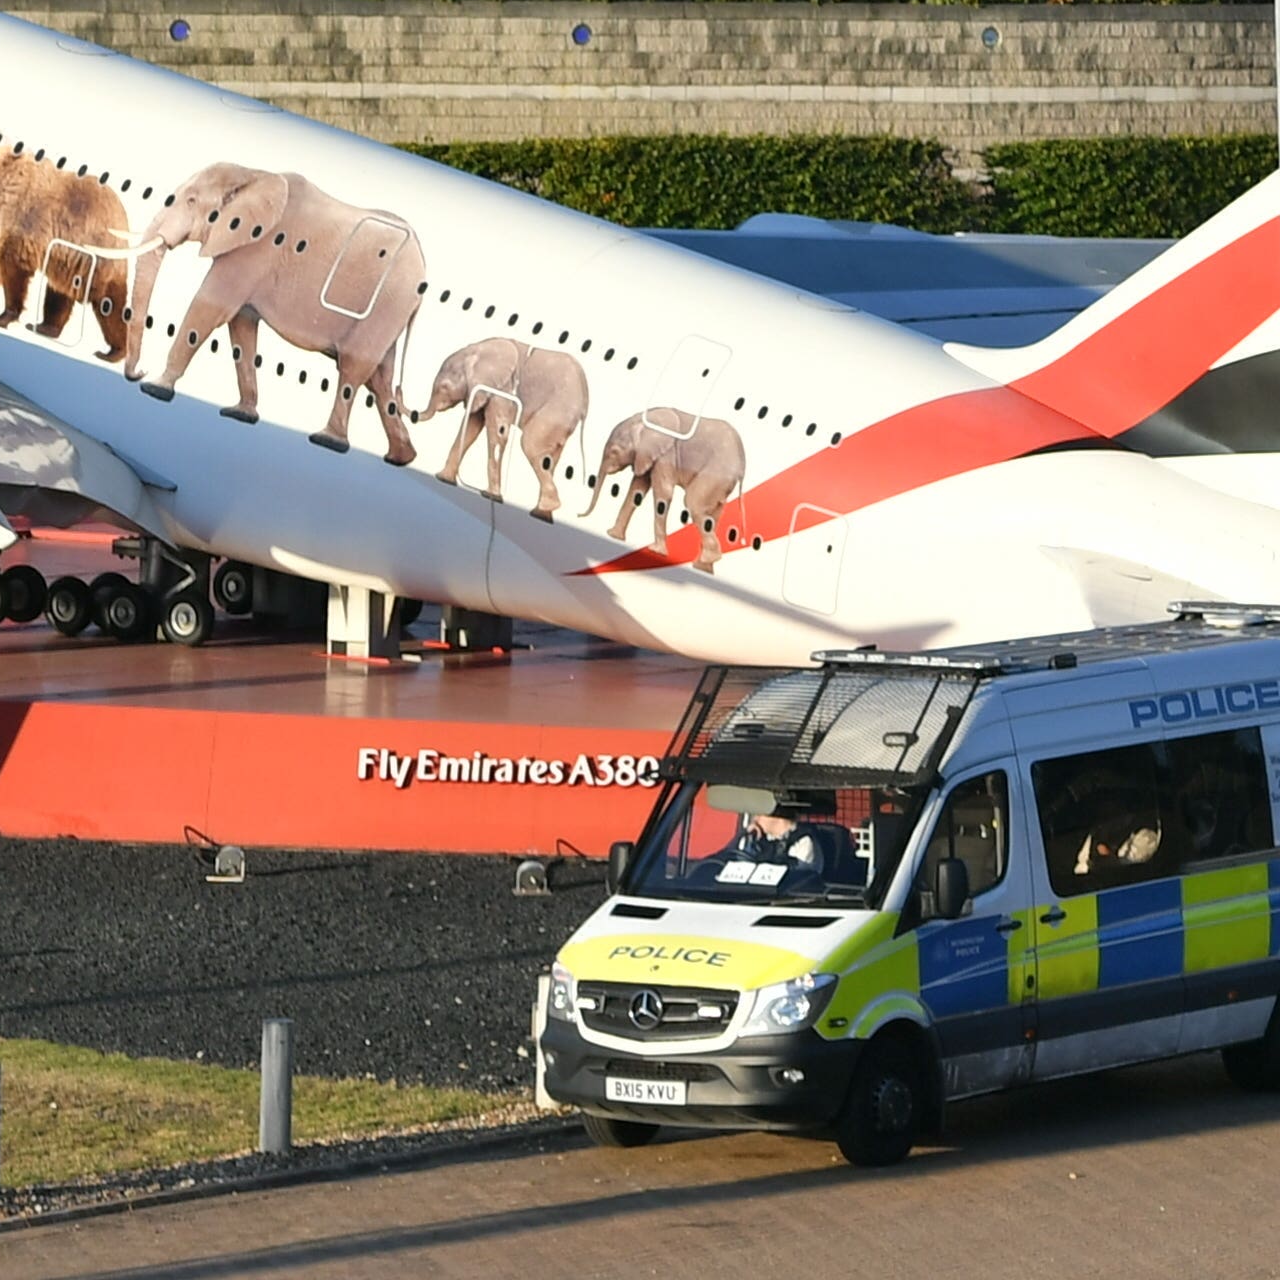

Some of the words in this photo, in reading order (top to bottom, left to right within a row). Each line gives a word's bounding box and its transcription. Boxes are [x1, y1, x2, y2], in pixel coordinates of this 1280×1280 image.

[357, 747, 411, 788] Fly
[416, 749, 564, 785] Emirates
[568, 753, 660, 788] A380
[608, 945, 732, 968] POLICE
[614, 1081, 643, 1099] BX15
[646, 1084, 676, 1101] KVU
